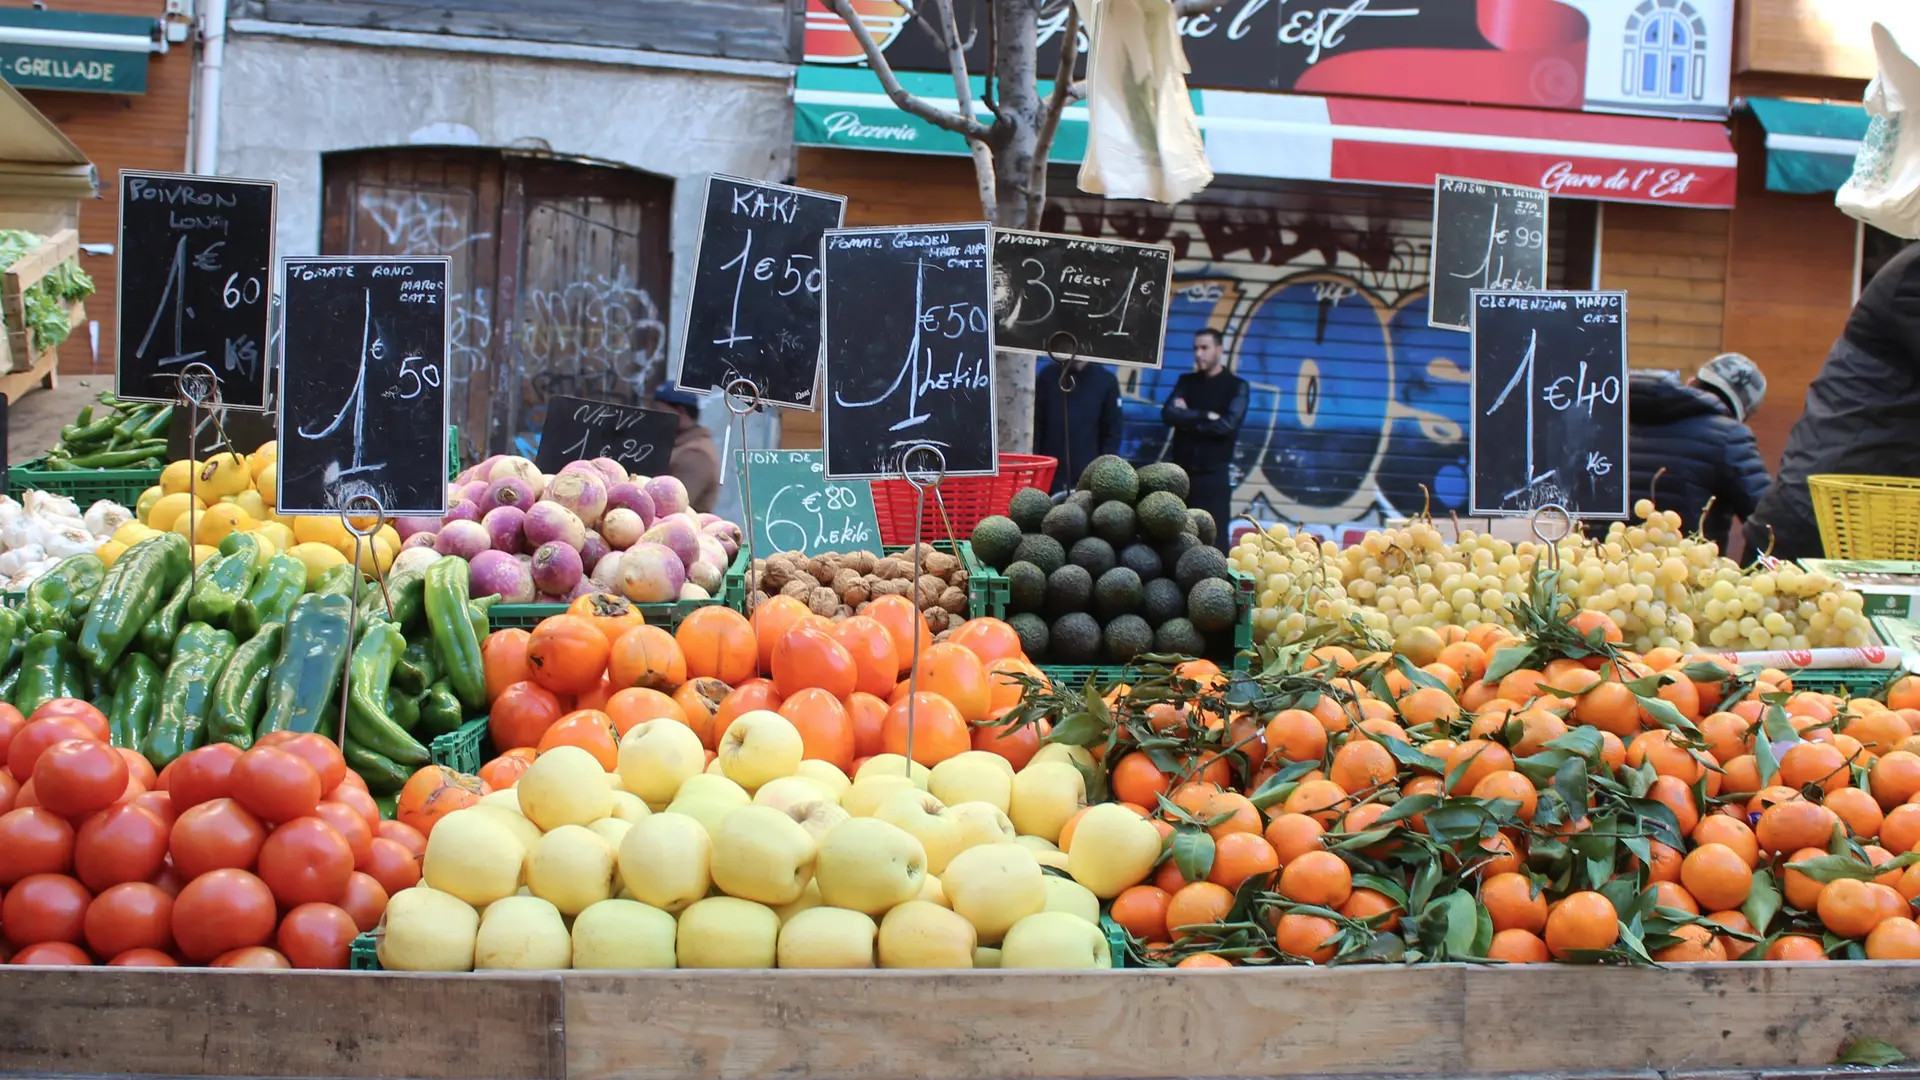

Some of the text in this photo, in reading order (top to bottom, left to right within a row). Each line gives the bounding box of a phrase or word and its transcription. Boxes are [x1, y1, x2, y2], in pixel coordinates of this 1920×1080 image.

[15, 56, 116, 83] GRILLADE
[823, 111, 918, 141] Pizzeria
[1540, 161, 1602, 193] Gare
[1603, 168, 1630, 190] de
[829, 235, 883, 250] POMME
[1586, 451, 1613, 476] KG
